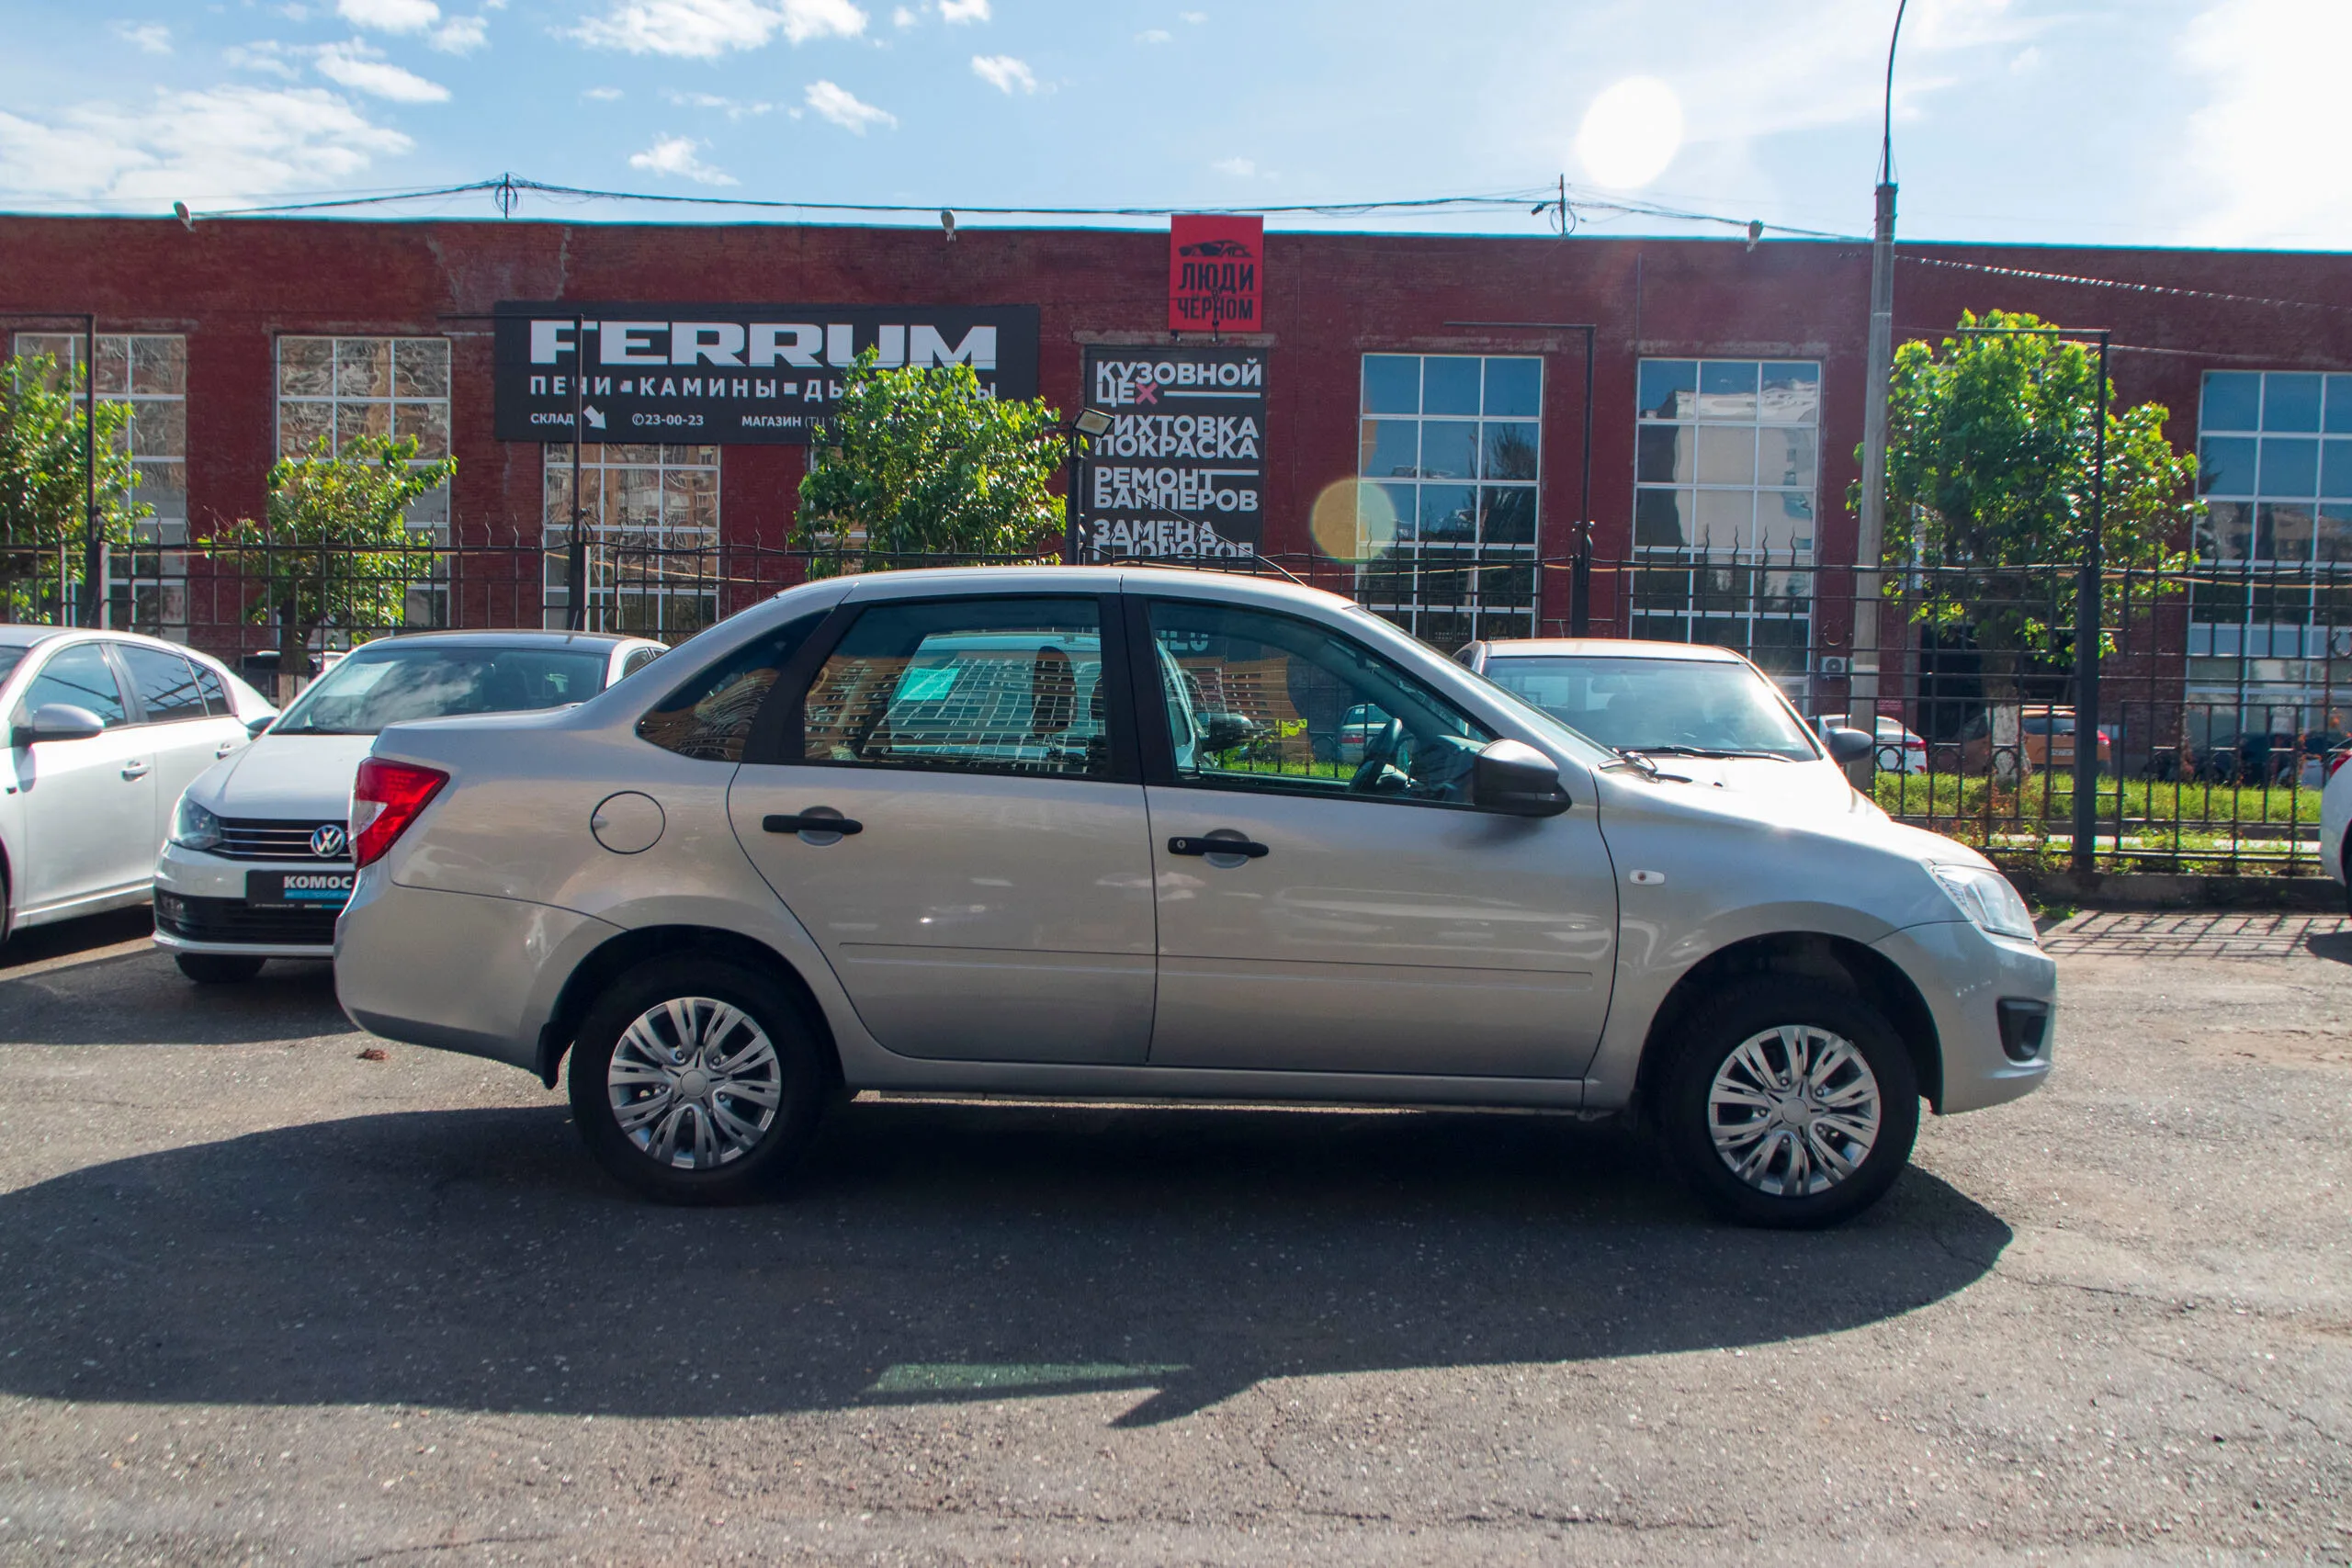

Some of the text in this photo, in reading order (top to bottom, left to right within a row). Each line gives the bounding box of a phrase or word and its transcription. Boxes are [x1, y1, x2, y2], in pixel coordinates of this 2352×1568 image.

[1178, 263, 1253, 294] ЛЮДИ
[530, 321, 997, 370] FERRUM
[1096, 357, 1261, 386] КУЗОВНОЙ
[639, 377, 776, 398] КАМИНЫ
[1096, 378, 1159, 407] ЦЕХ
[530, 412, 574, 426] СКЛАД
[645, 413, 705, 426] 23-00-23
[741, 415, 801, 427] МАГАЗИН
[1113, 413, 1260, 439] ИХТОВКА
[1095, 434, 1260, 459] ПОКРАСКА
[1094, 467, 1214, 492] РЕМОНТ
[1094, 486, 1259, 513] БАМПЕРОВ
[1092, 518, 1218, 543] ЗАМЕНА
[283, 875, 353, 890] КОМОС
